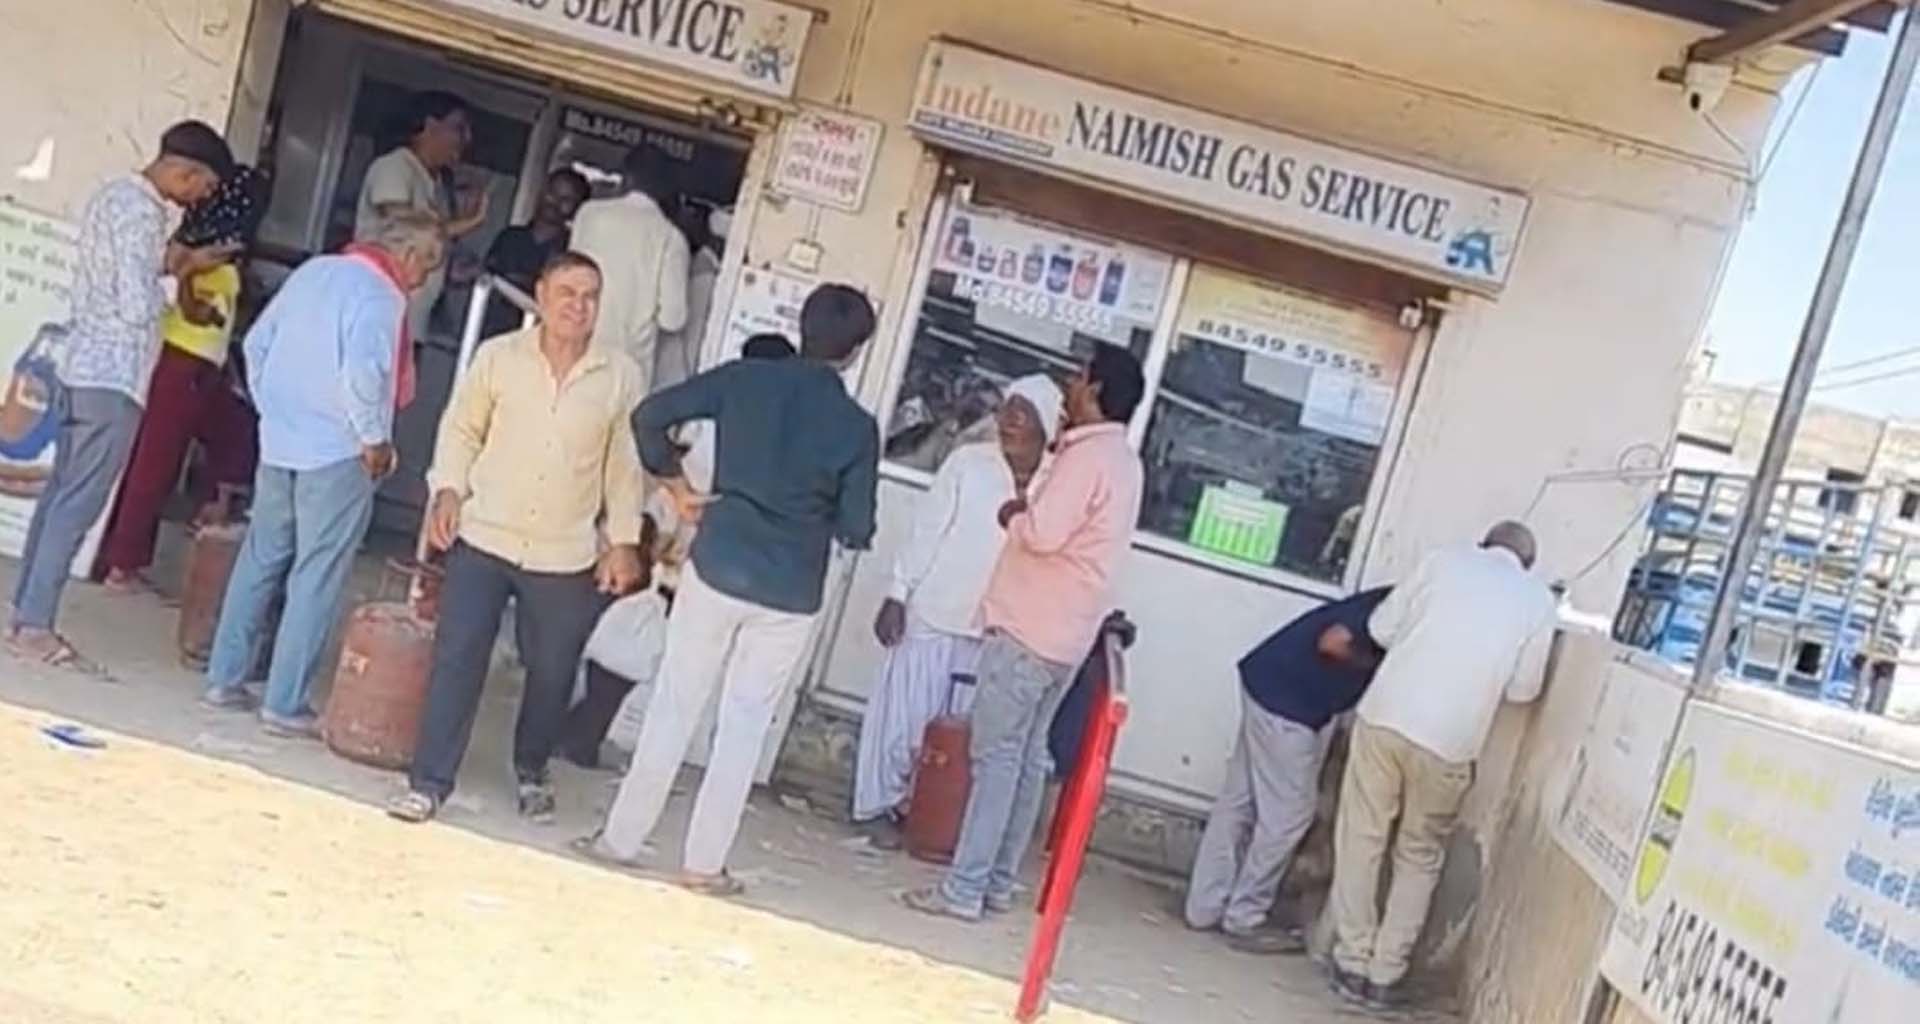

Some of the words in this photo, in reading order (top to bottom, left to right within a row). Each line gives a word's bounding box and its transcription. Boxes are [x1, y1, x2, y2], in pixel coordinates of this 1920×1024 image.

[1066, 101, 1223, 180] NAIMISH
[1227, 144, 1296, 202] GAS
[1301, 164, 1450, 243] SERVICE
[1198, 318, 1286, 348] 84549
[1295, 344, 1382, 378] 55555
